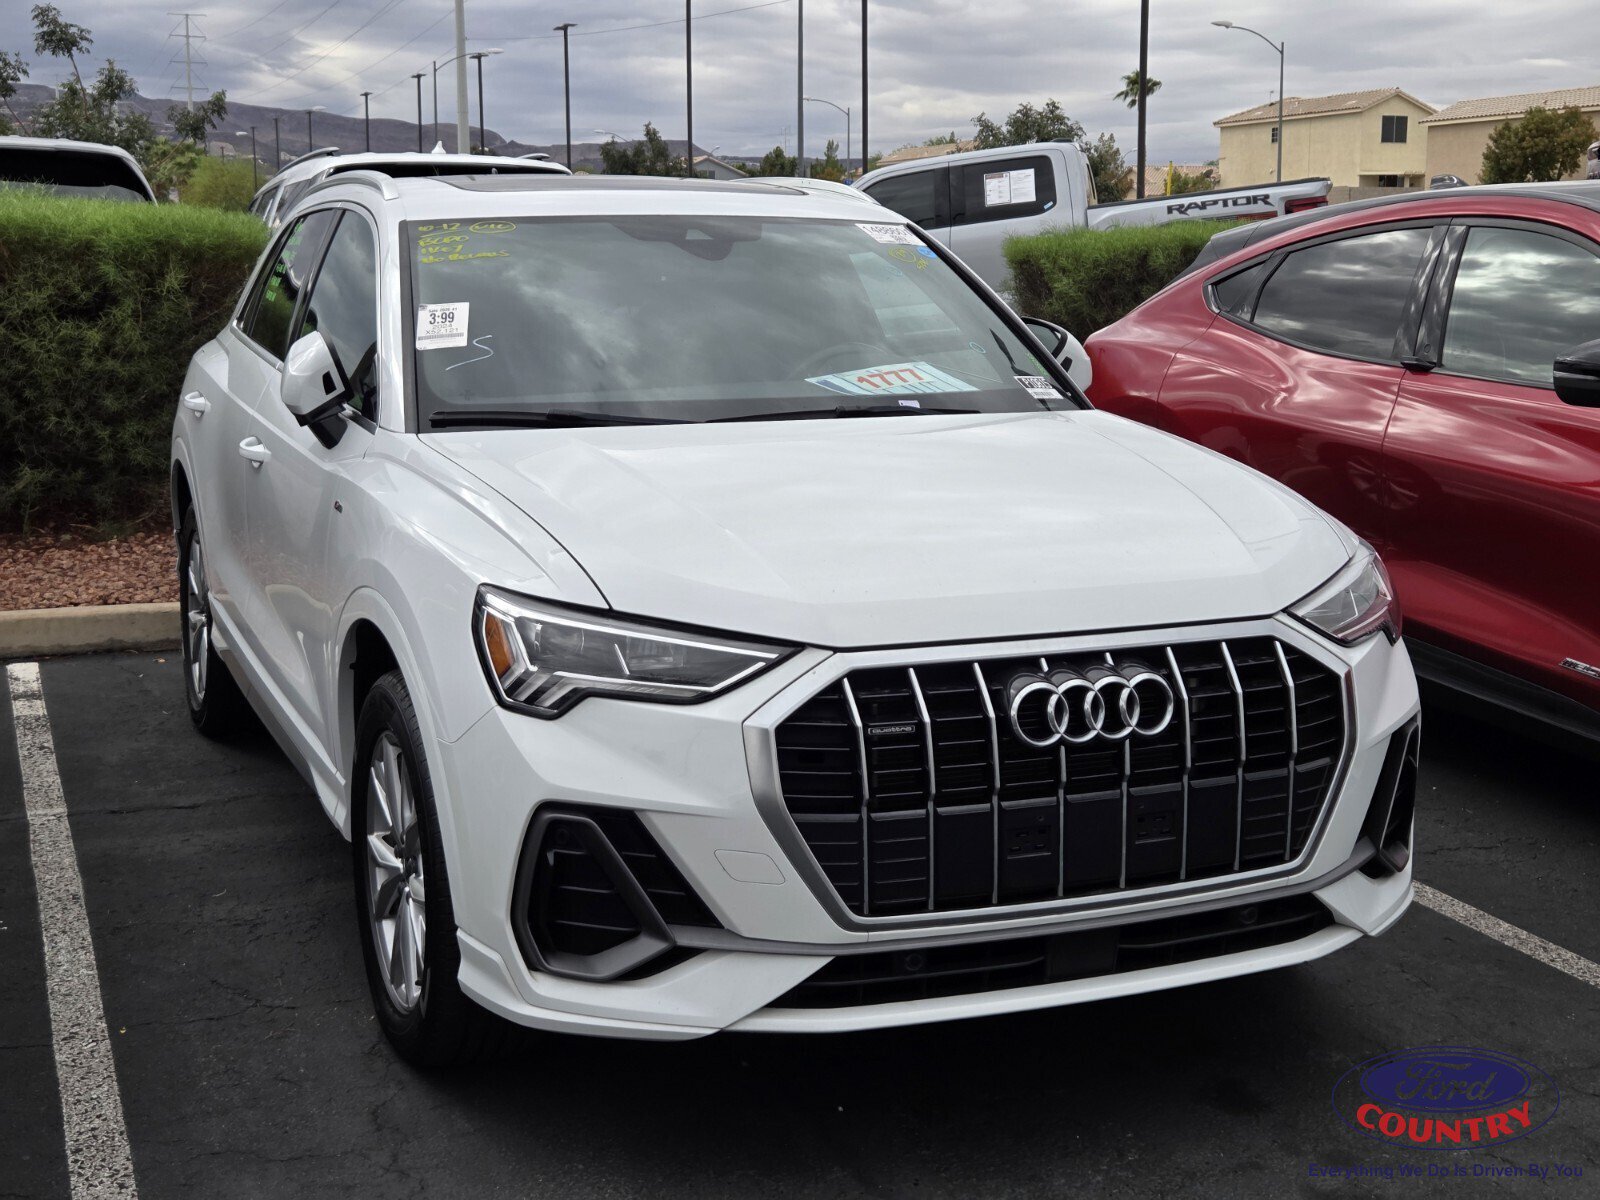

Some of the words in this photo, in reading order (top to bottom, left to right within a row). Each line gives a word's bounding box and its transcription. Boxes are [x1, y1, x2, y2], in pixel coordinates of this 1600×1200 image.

[1166, 193, 1275, 216] RAPTOR
[429, 311, 455, 325] 3:99
[857, 368, 925, 389] 1777
